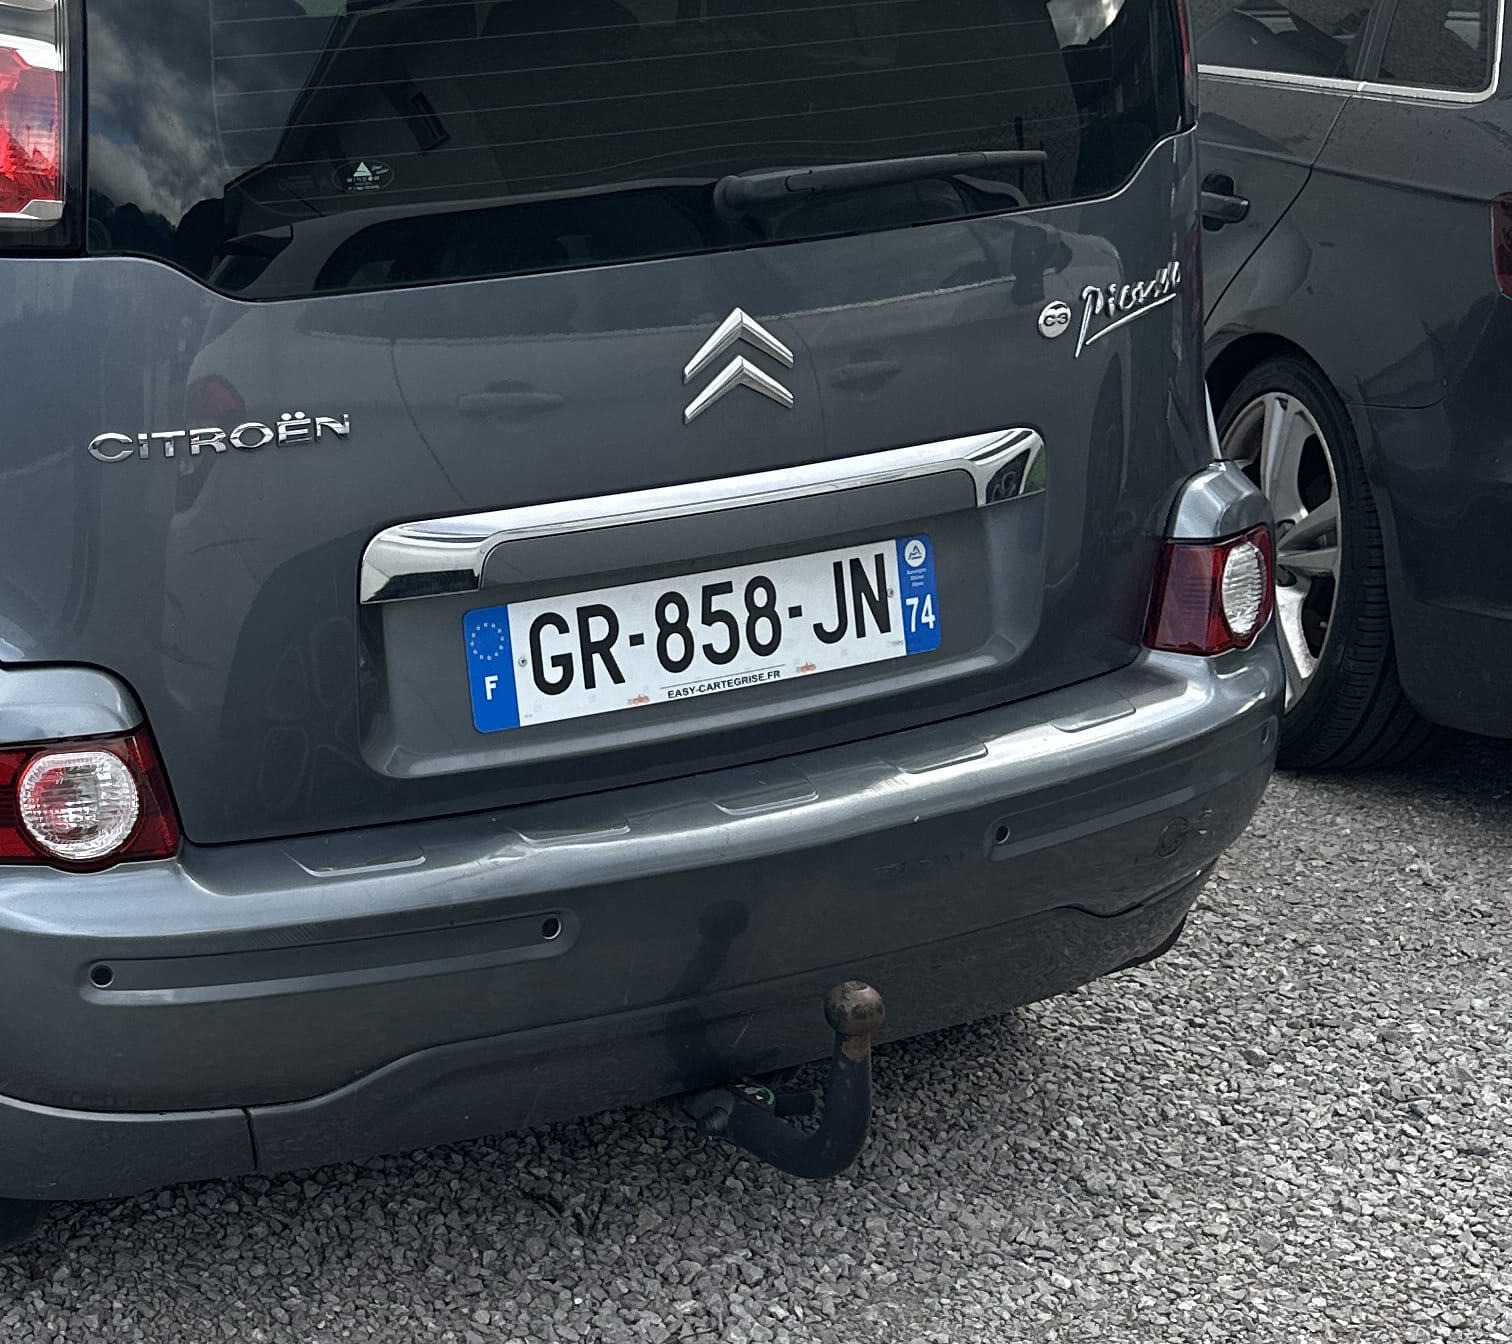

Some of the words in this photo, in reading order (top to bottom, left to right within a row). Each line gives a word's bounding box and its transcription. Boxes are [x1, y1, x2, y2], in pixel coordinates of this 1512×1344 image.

[88, 411, 351, 463] CITROËN
[529, 553, 892, 696] GR-858-JN
[905, 593, 936, 633] 74
[484, 674, 499, 701] F
[666, 670, 781, 699] EASY-CARTEGRISE.FR
